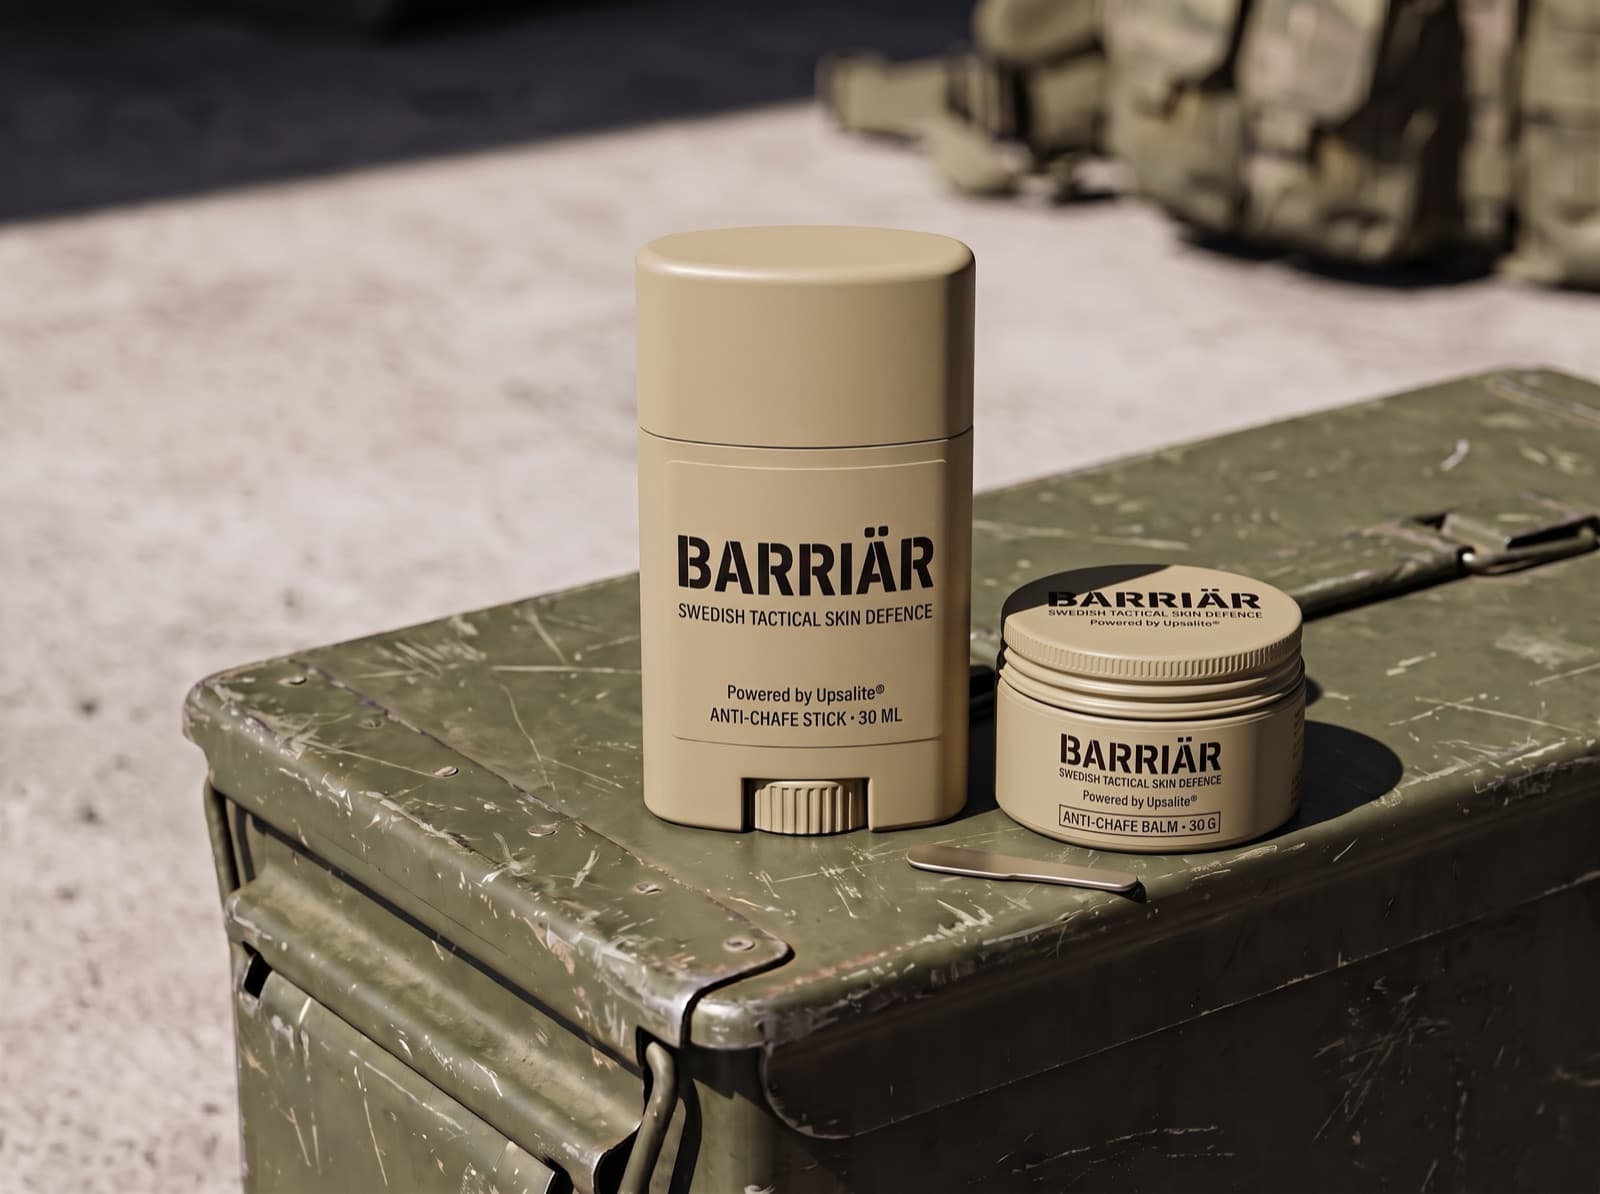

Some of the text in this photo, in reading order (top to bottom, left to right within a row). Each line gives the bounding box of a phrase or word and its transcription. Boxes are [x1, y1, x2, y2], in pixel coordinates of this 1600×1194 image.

[677, 525, 934, 596] BARRIÄR
[1047, 588, 1261, 610] BARRIÄR
[678, 602, 933, 627] SWEDISH TACTICAL SKIN DEFENCE
[1090, 618, 1142, 627] Powered
[1145, 618, 1160, 628] by
[1110, 610, 1168, 618] TACTICAL
[1171, 610, 1201, 618] SKIN
[1205, 611, 1263, 619] DEFENCE
[727, 684, 791, 703] Powered
[795, 688, 812, 706] by
[710, 707, 799, 727] ANTI-CHAFE
[803, 710, 847, 727] STICK
[858, 709, 877, 725] 30
[881, 707, 903, 723] ML
[1060, 733, 1222, 775] BARRIÄR
[1059, 767, 1222, 788] SWEDISH TACTICAL SKIN DEFENCE
[1083, 790, 1129, 806] Powered
[1131, 794, 1145, 810] by
[1063, 810, 1138, 832] ANTI-CHAFE
[1141, 821, 1178, 833] BALM
[1189, 817, 1205, 831] 30
[1207, 815, 1216, 830] G
